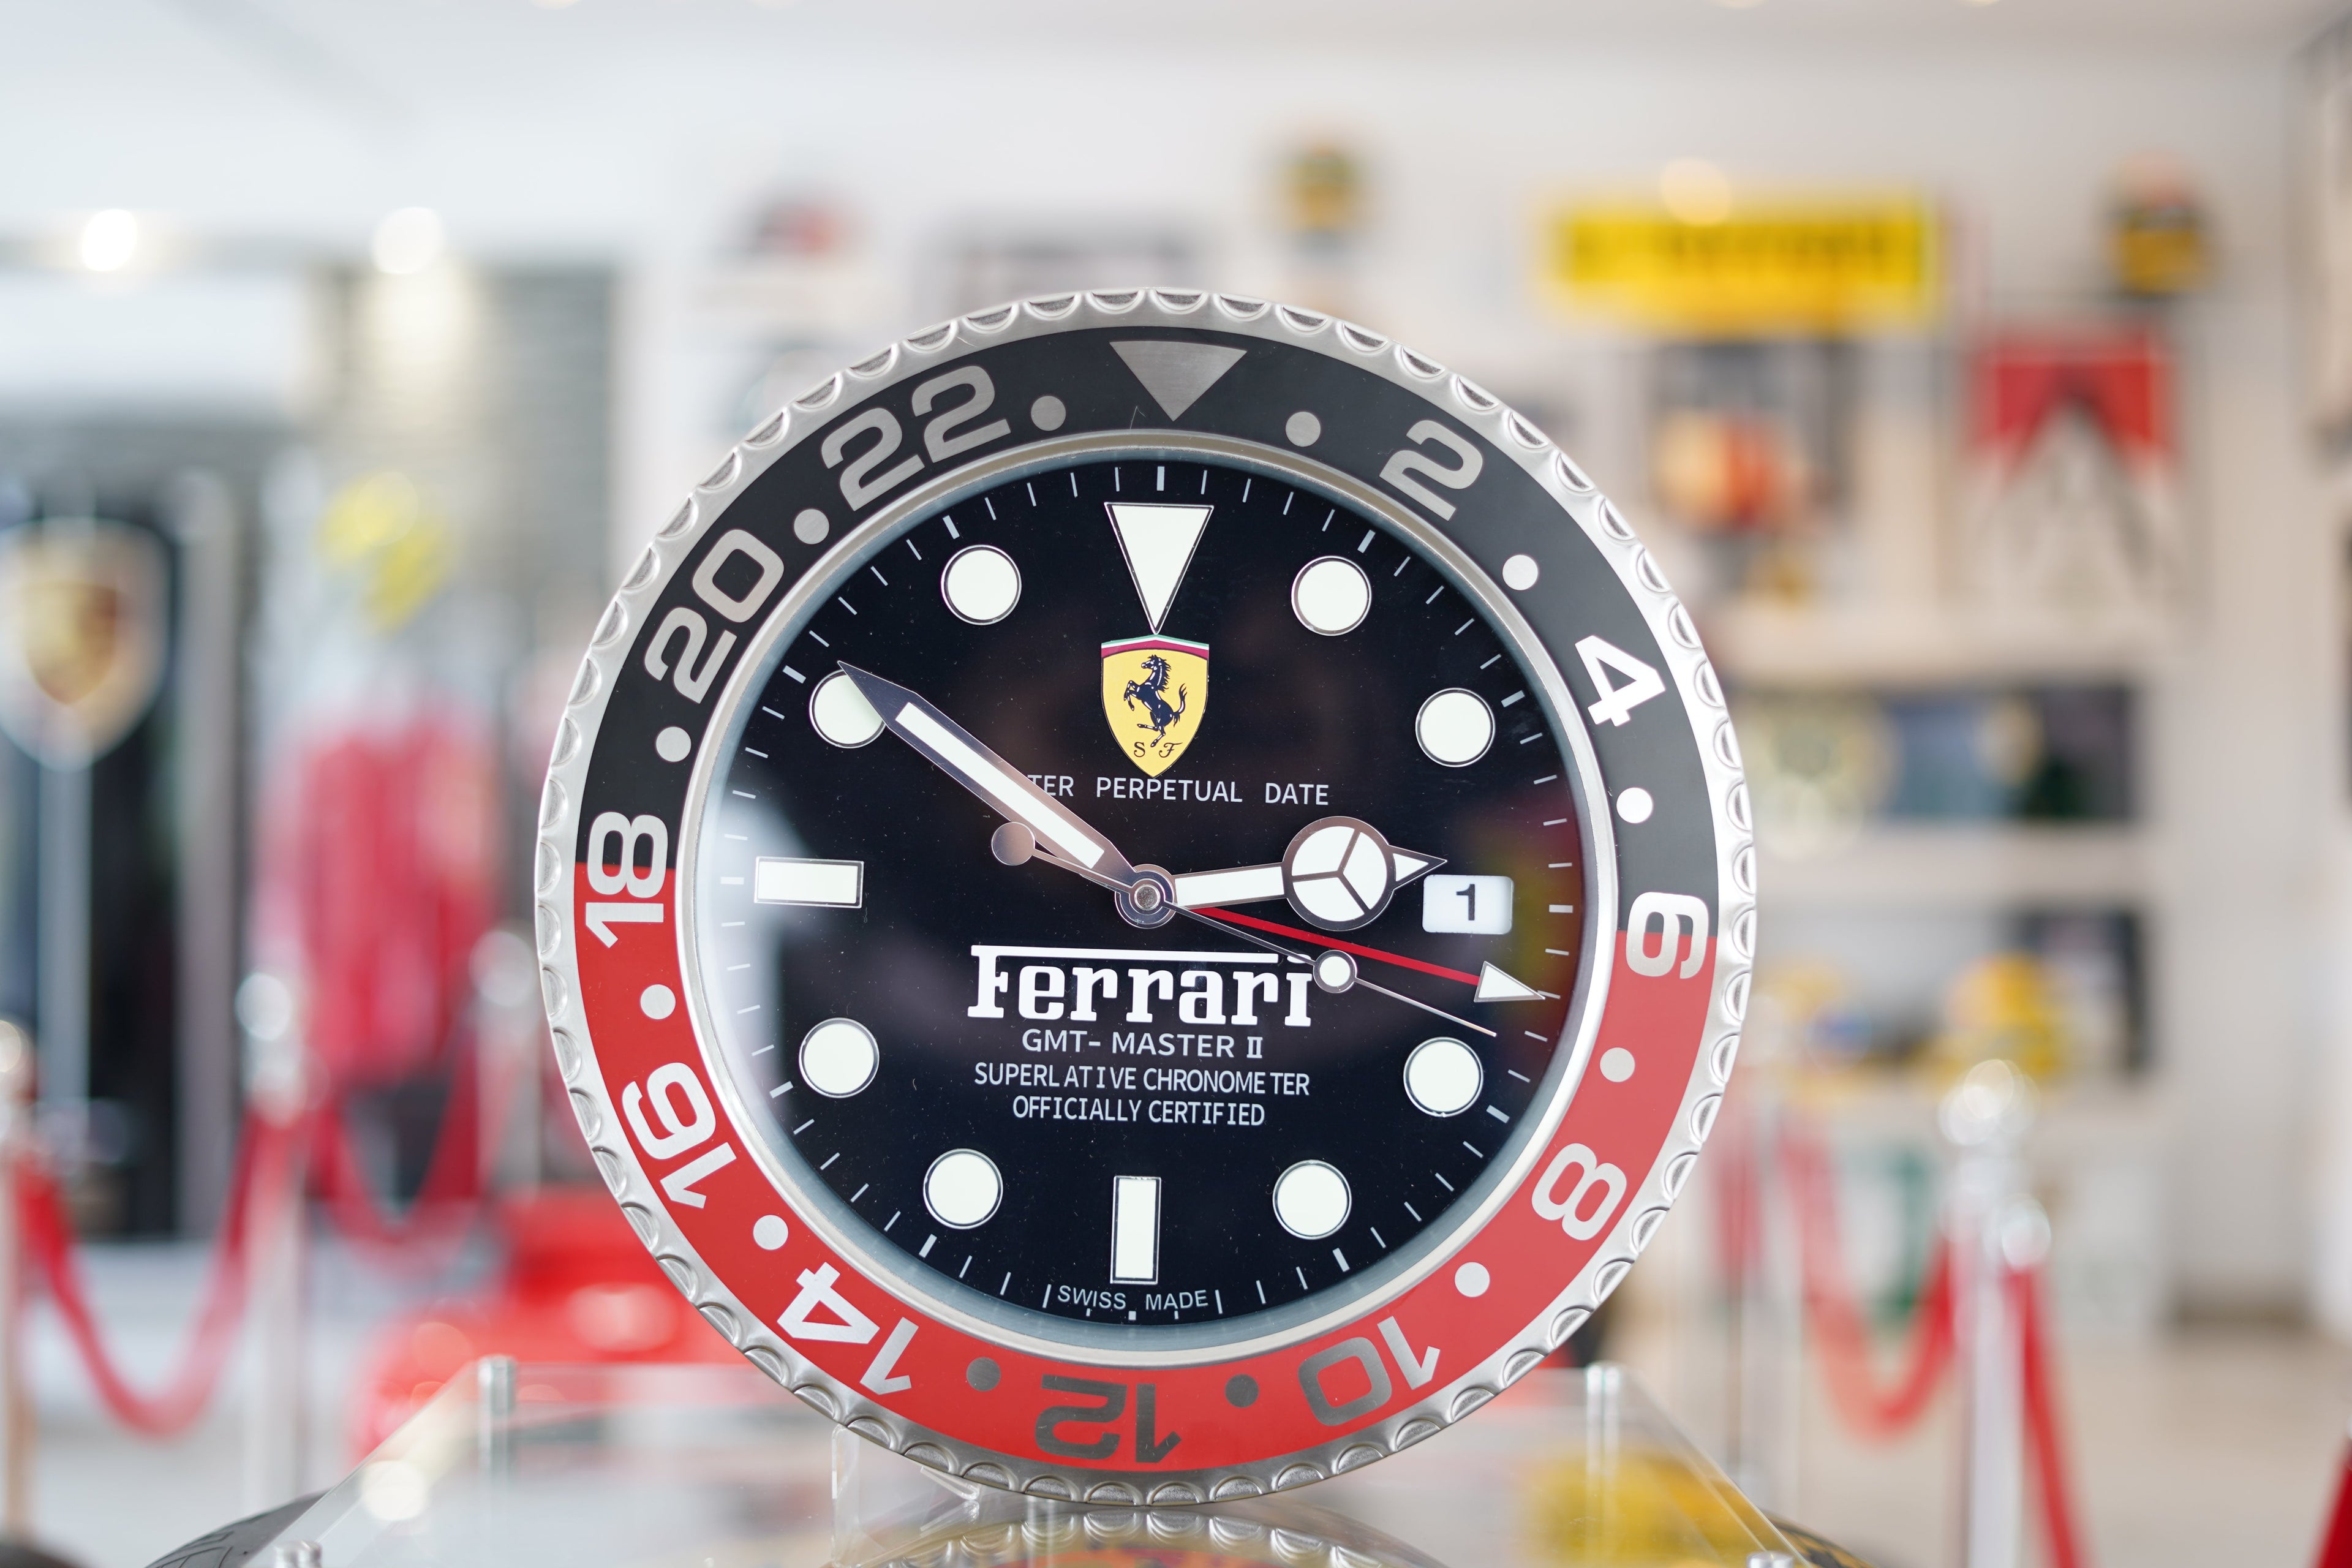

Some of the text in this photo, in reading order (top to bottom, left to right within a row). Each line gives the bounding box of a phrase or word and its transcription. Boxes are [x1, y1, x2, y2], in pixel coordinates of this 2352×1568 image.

[821, 366, 1011, 511] 22
[1379, 420, 1483, 521] 2
[644, 529, 784, 704] 20
[1575, 635, 1666, 727] 4
[1027, 775, 1329, 805] TER PERPETUAL DATE
[1134, 742, 1183, 758] S F
[585, 812, 668, 948] 18
[1456, 884, 1475, 921] 1
[1626, 892, 1709, 979] 6
[968, 944, 1313, 1027] Ferrari
[975, 1062, 1136, 1089] SUPERLATIVE
[1022, 1029, 1262, 1058] GMT- MASTER II
[622, 1062, 737, 1209] 16
[1013, 1096, 1264, 1125] OFFICIALLY CERTIFIED
[1531, 1142, 1627, 1241] 8
[777, 1262, 919, 1395] 14
[1058, 1286, 1208, 1310] SWISS MADE
[1298, 1315, 1440, 1427] 10
[1035, 1374, 1181, 1464] 12
